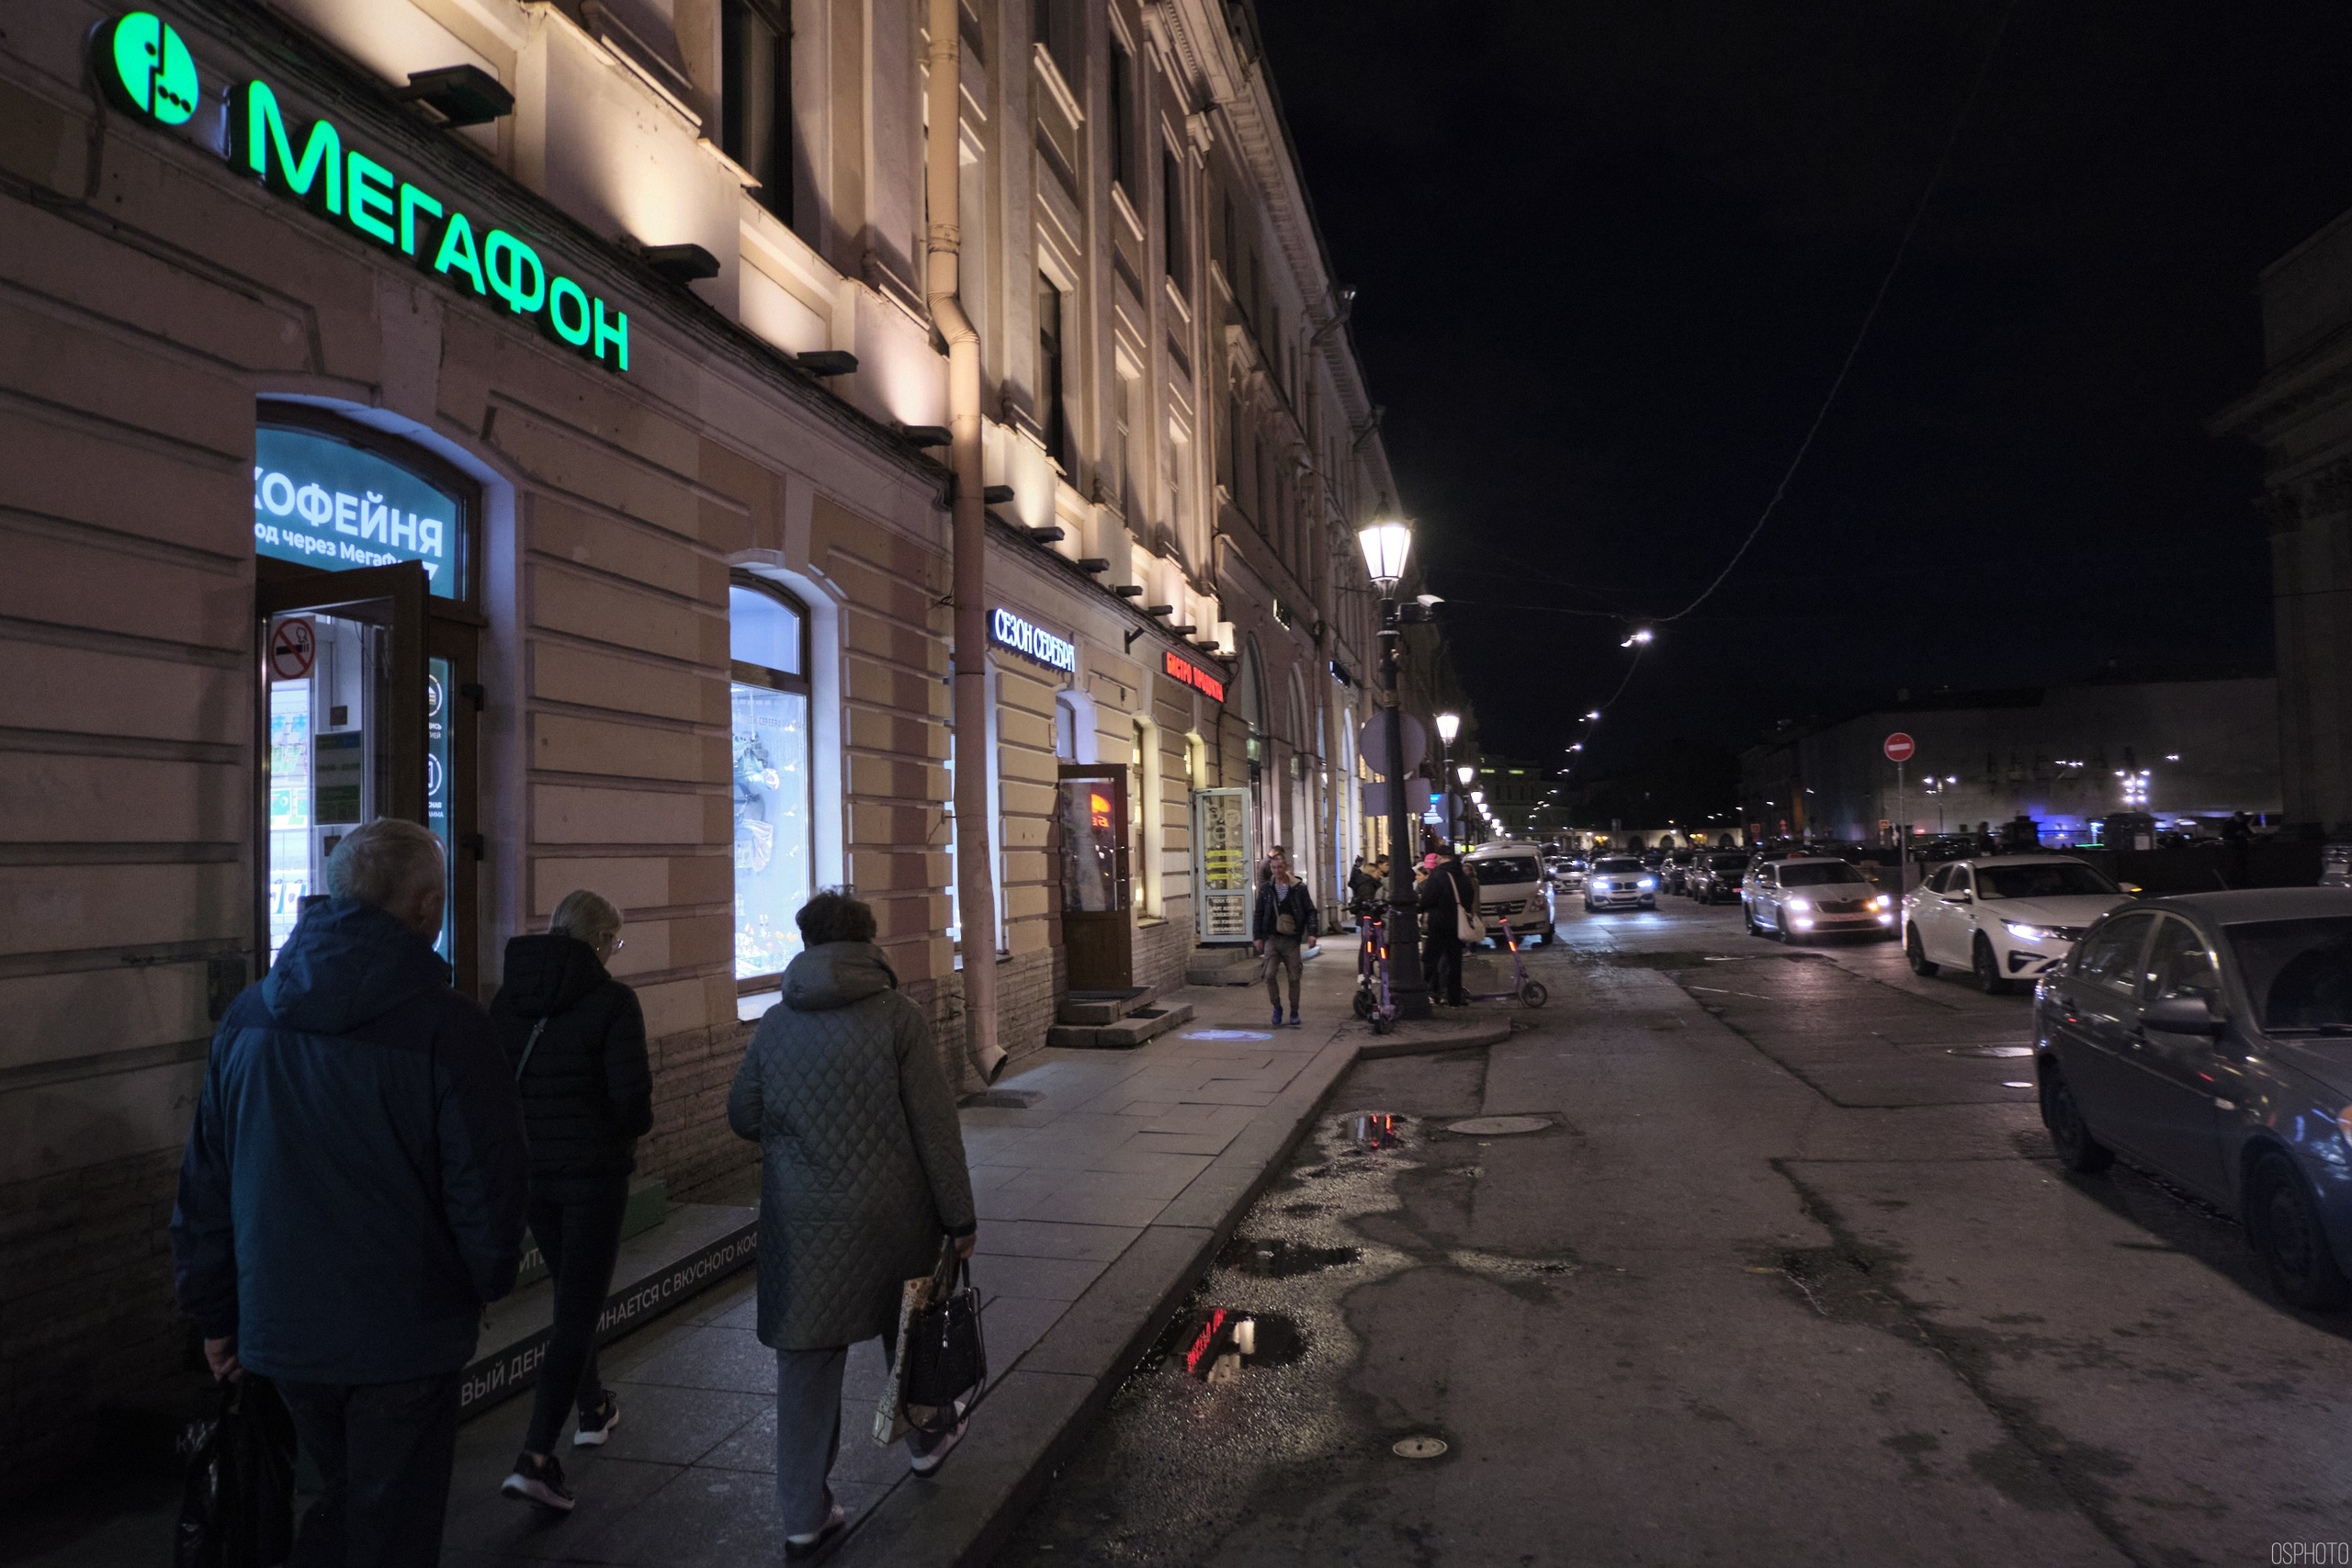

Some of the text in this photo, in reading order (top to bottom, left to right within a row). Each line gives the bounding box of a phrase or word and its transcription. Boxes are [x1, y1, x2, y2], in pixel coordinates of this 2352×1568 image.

[249, 79, 628, 371] МЕГАФОН
[282, 529, 336, 555] через
[995, 608, 1075, 672] СЕЗОН СЕРЕБРА
[673, 1246, 735, 1292] ВКУСНОГО
